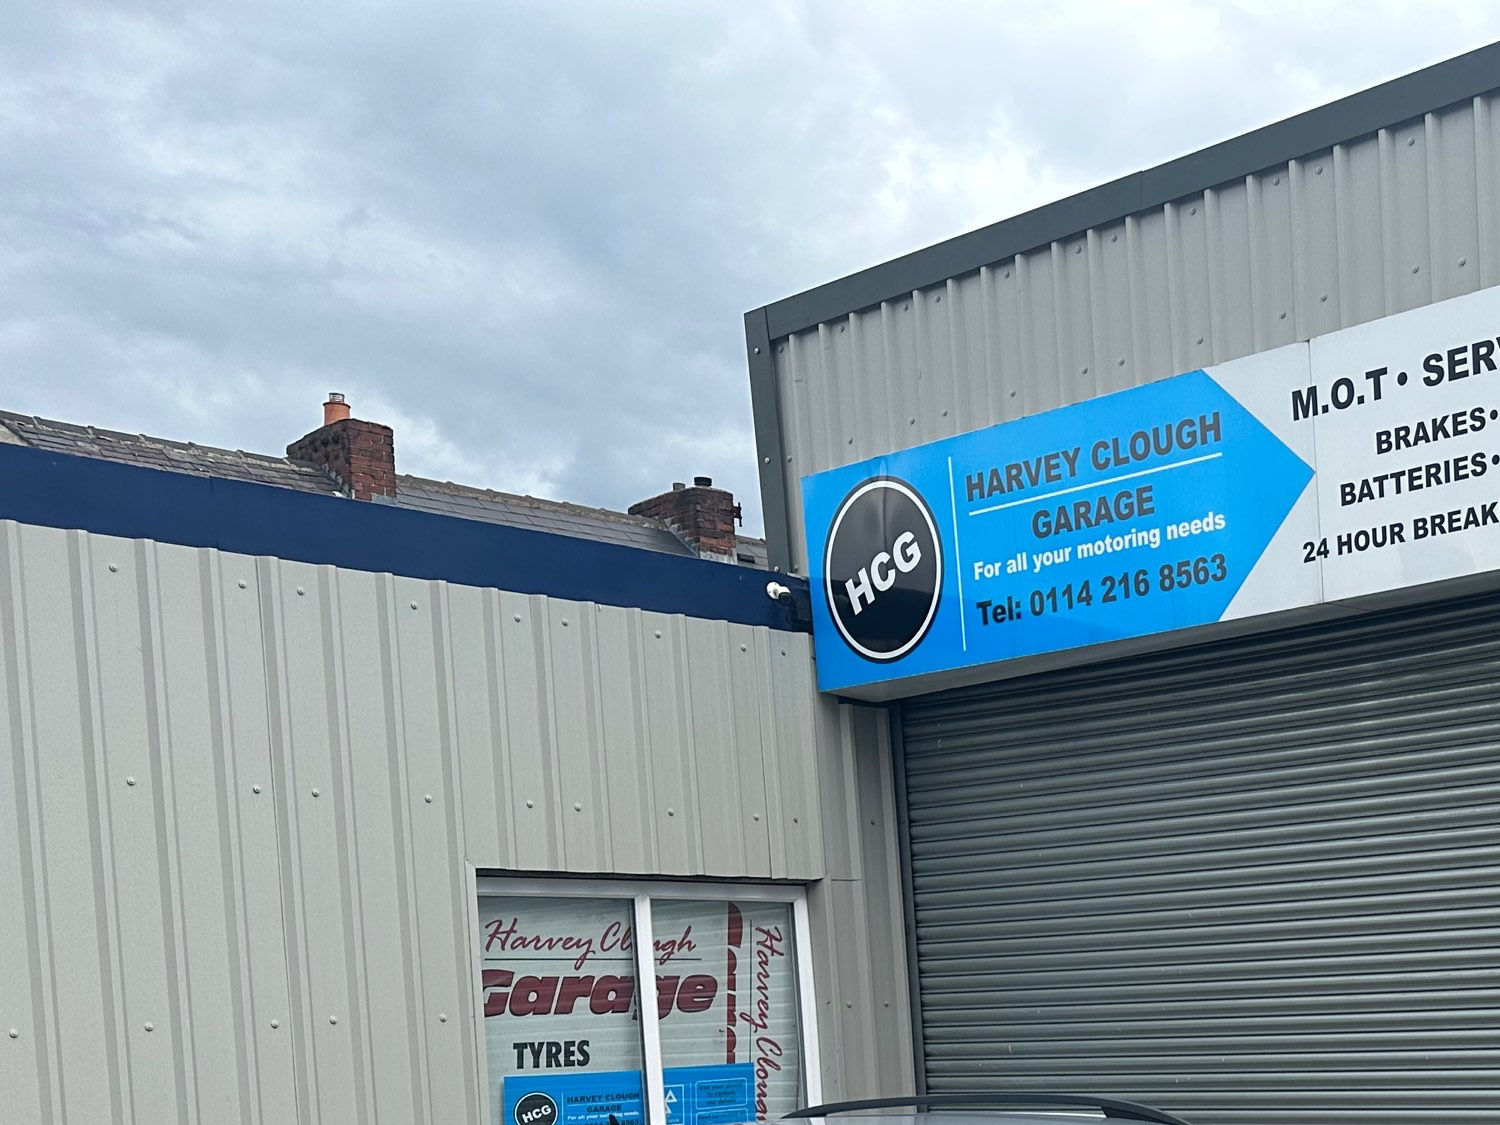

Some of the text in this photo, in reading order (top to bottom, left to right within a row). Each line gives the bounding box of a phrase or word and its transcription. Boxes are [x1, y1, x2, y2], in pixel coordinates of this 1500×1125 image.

[1291, 366, 1389, 421] M.O.T
[966, 411, 1223, 503] HARVEY CLOUGH
[1376, 406, 1487, 455] BRAKES
[1340, 451, 1488, 507] BATTERIES
[1032, 485, 1155, 540] GARAGE
[973, 511, 1226, 581] For all your motoring needs
[1302, 538, 1330, 564] 24
[1336, 522, 1405, 557] HOUR
[845, 530, 922, 616] HCG
[976, 553, 1228, 627] Tel: 0114 216 8563
[484, 918, 697, 970] Harvey Clugh
[739, 926, 785, 1033] Harvey
[513, 1040, 591, 1070] TYRES
[521, 1105, 552, 1123] HCG
[567, 1092, 640, 1104] HARVEY CLOUGH
[586, 1105, 621, 1113] GARAGE
